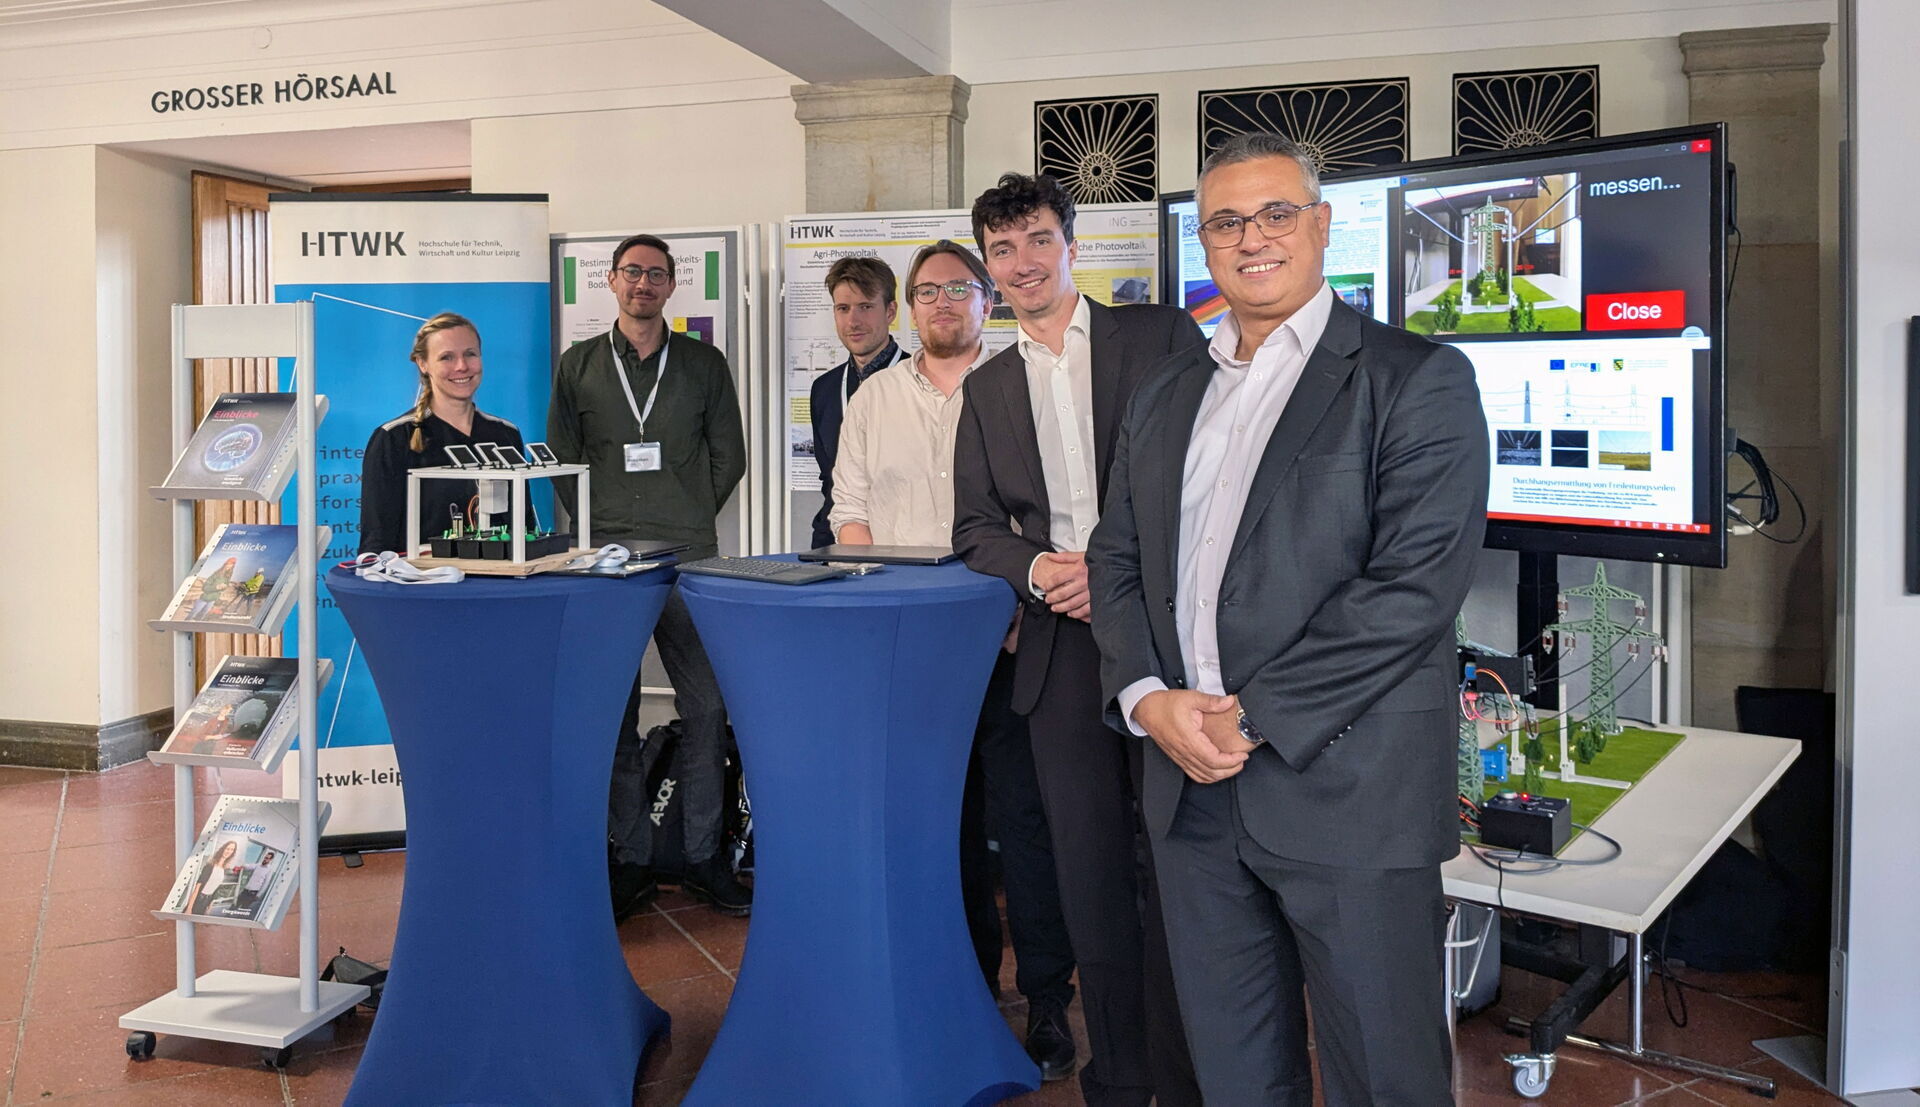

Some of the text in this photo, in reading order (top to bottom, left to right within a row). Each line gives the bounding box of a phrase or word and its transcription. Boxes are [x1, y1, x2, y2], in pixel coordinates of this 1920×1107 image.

[151, 72, 397, 113] GROSSER HÖRSAAL
[1589, 176, 1681, 197] messen...
[790, 225, 835, 239] HTWK
[301, 231, 407, 257] HTWK
[419, 240, 503, 249] Hochschule für Technik,
[1095, 241, 1147, 251] Photovoltaik
[419, 249, 454, 257] Wirtschaft
[471, 249, 493, 257] Kultur
[495, 249, 520, 258] Leipzig
[813, 248, 878, 259] Agri-Photovoltaik
[587, 269, 603, 278] und
[683, 267, 693, 275] im
[677, 278, 693, 286] und
[1607, 302, 1662, 321] Close
[214, 410, 260, 419] Einblicke
[222, 542, 267, 552] Einblicke
[321, 545, 357, 559] zuk
[220, 674, 265, 685] Einblicke
[222, 821, 266, 834] Einblicke
